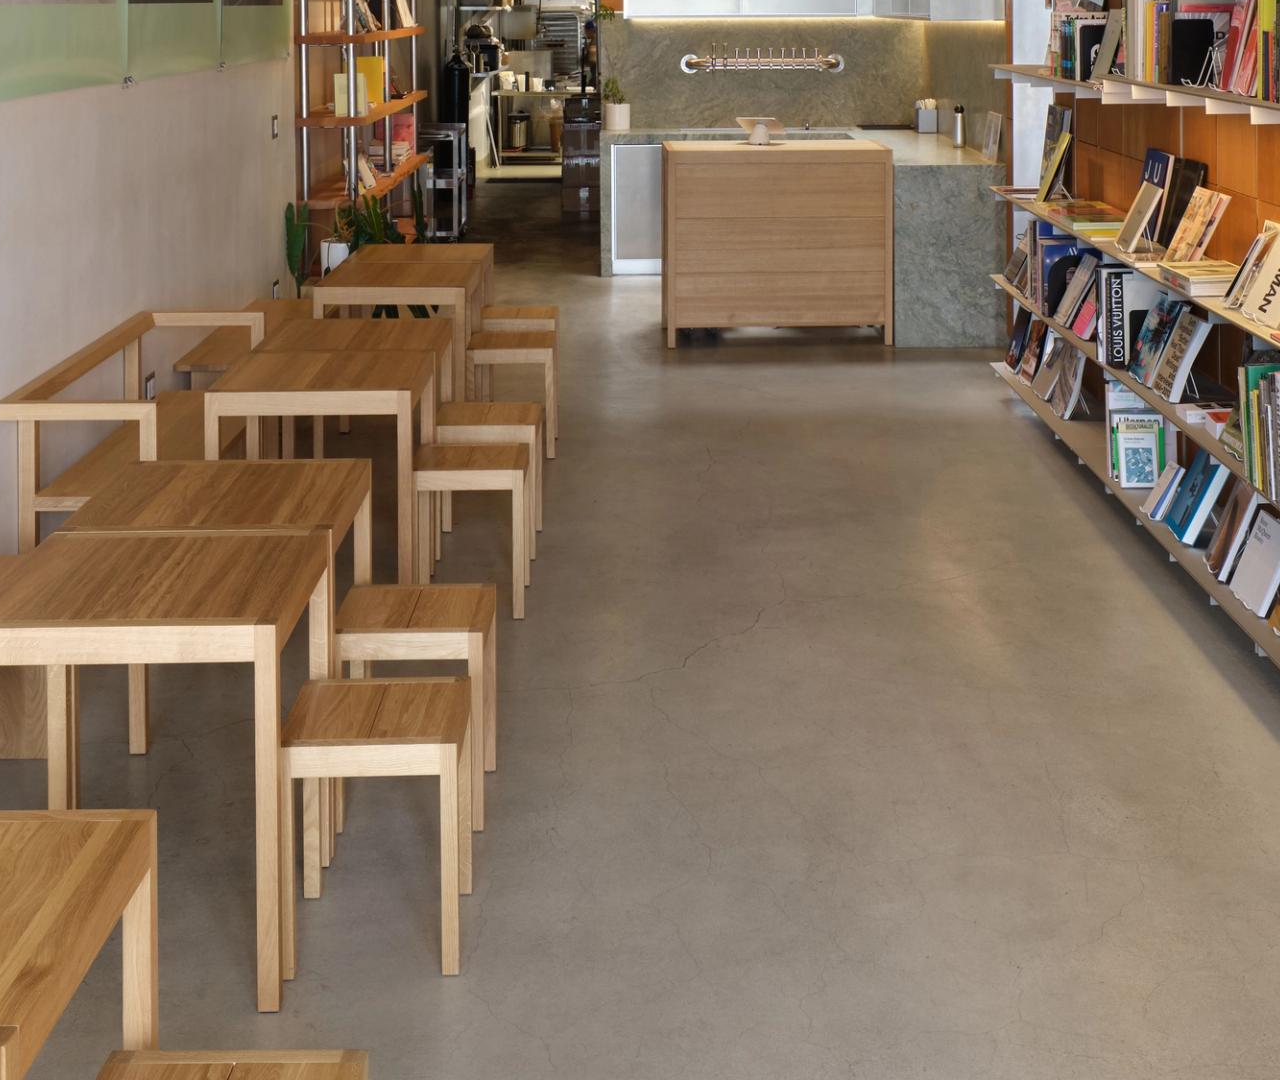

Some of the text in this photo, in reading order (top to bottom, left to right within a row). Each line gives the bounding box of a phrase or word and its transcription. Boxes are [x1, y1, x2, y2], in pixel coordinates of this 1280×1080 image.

[1144, 160, 1162, 183] JU
[1112, 278, 1124, 362] LOUIS VUITTON
